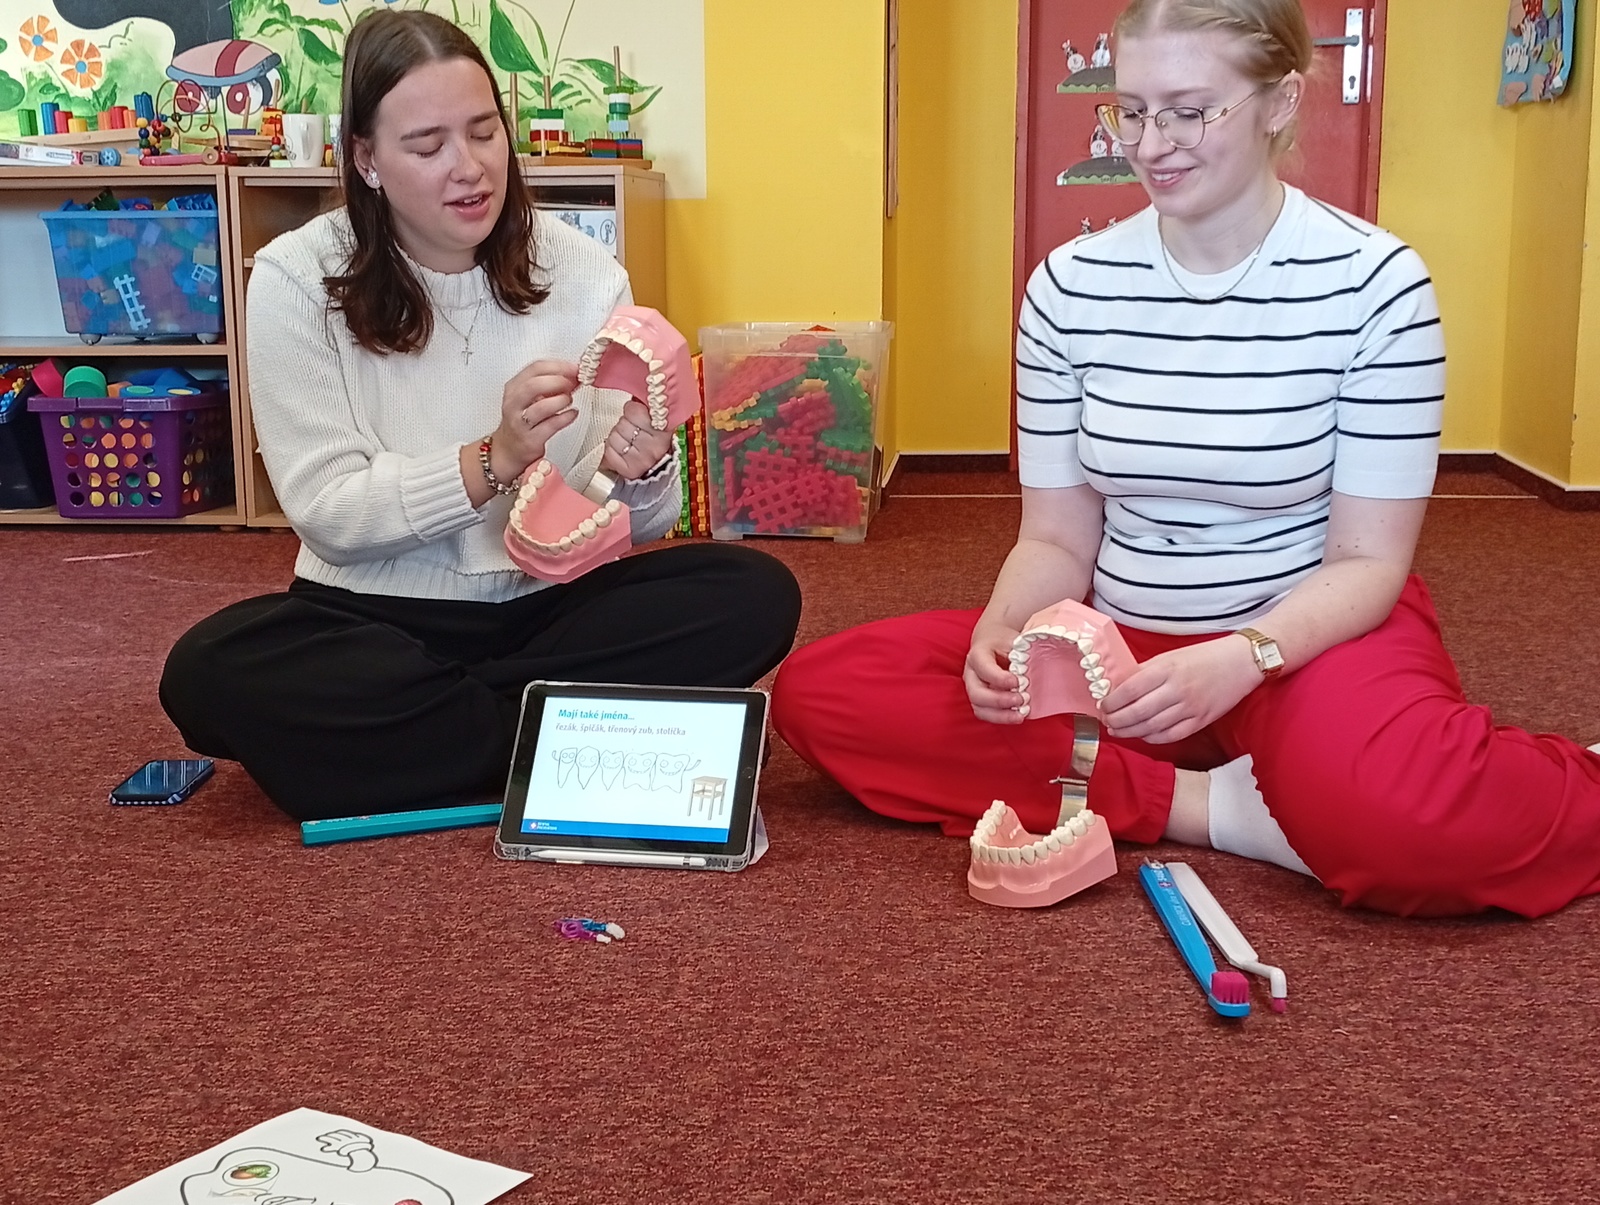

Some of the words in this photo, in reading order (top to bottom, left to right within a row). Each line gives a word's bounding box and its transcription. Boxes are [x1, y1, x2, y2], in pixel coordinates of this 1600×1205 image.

[558, 709, 578, 720] Mají
[580, 709, 599, 719] také
[608, 725, 637, 735] třenový
[638, 727, 654, 735] zub,
